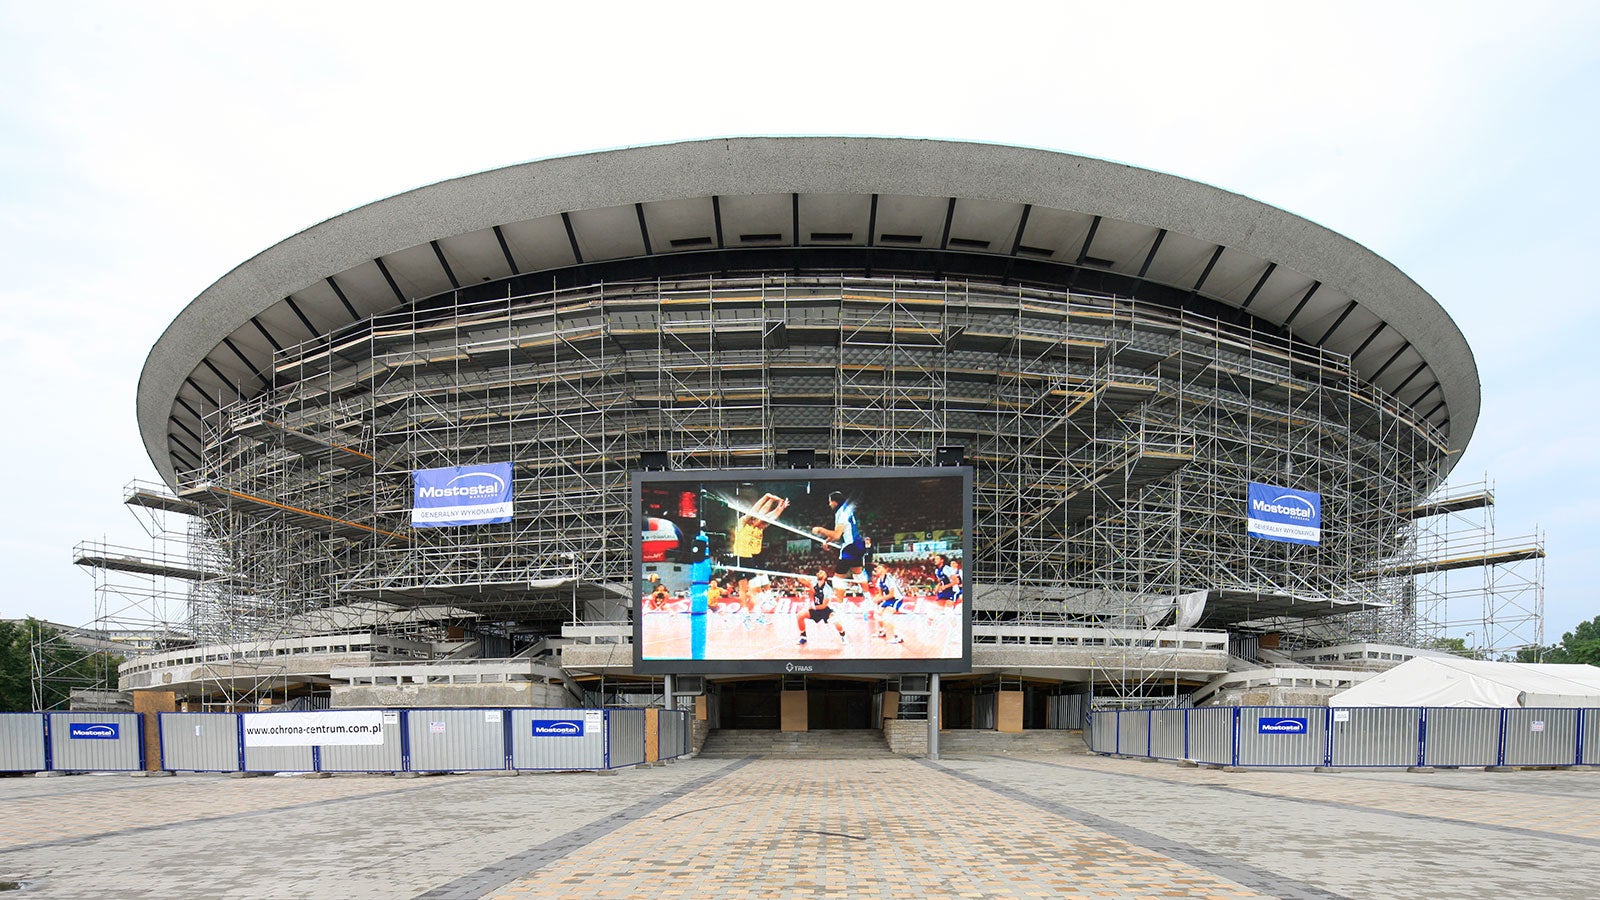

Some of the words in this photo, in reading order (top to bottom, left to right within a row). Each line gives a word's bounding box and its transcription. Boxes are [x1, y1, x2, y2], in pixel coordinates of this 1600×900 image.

[420, 482, 498, 498] Mostostal
[421, 510, 459, 519] GENERALNY
[1253, 499, 1311, 518] Mostostal
[247, 723, 382, 736] www.ochrona-centrum.com.pl
